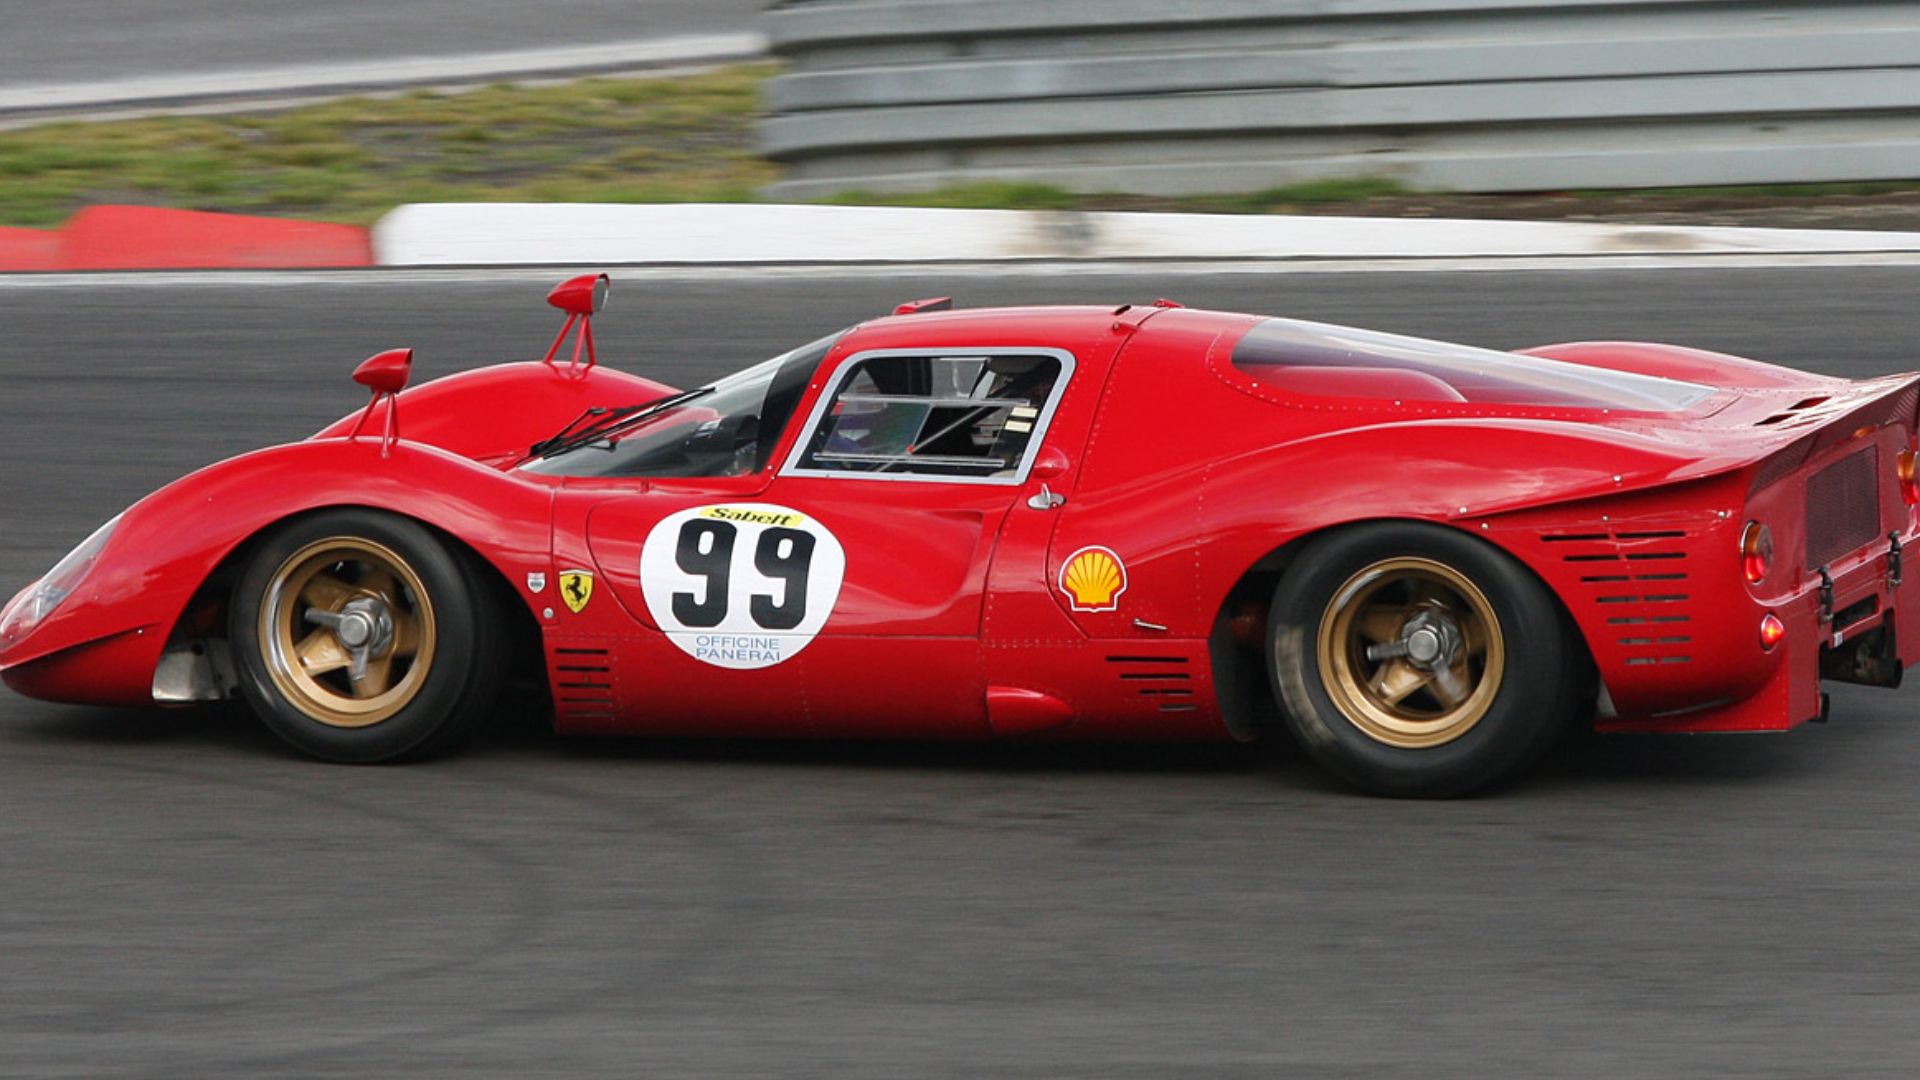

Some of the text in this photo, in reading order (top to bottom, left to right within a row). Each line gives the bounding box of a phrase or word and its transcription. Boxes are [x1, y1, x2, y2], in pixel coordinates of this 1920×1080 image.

[672, 518, 816, 629] 99
[696, 635, 780, 650] OFFICINE
[696, 647, 780, 662] PANERAI
